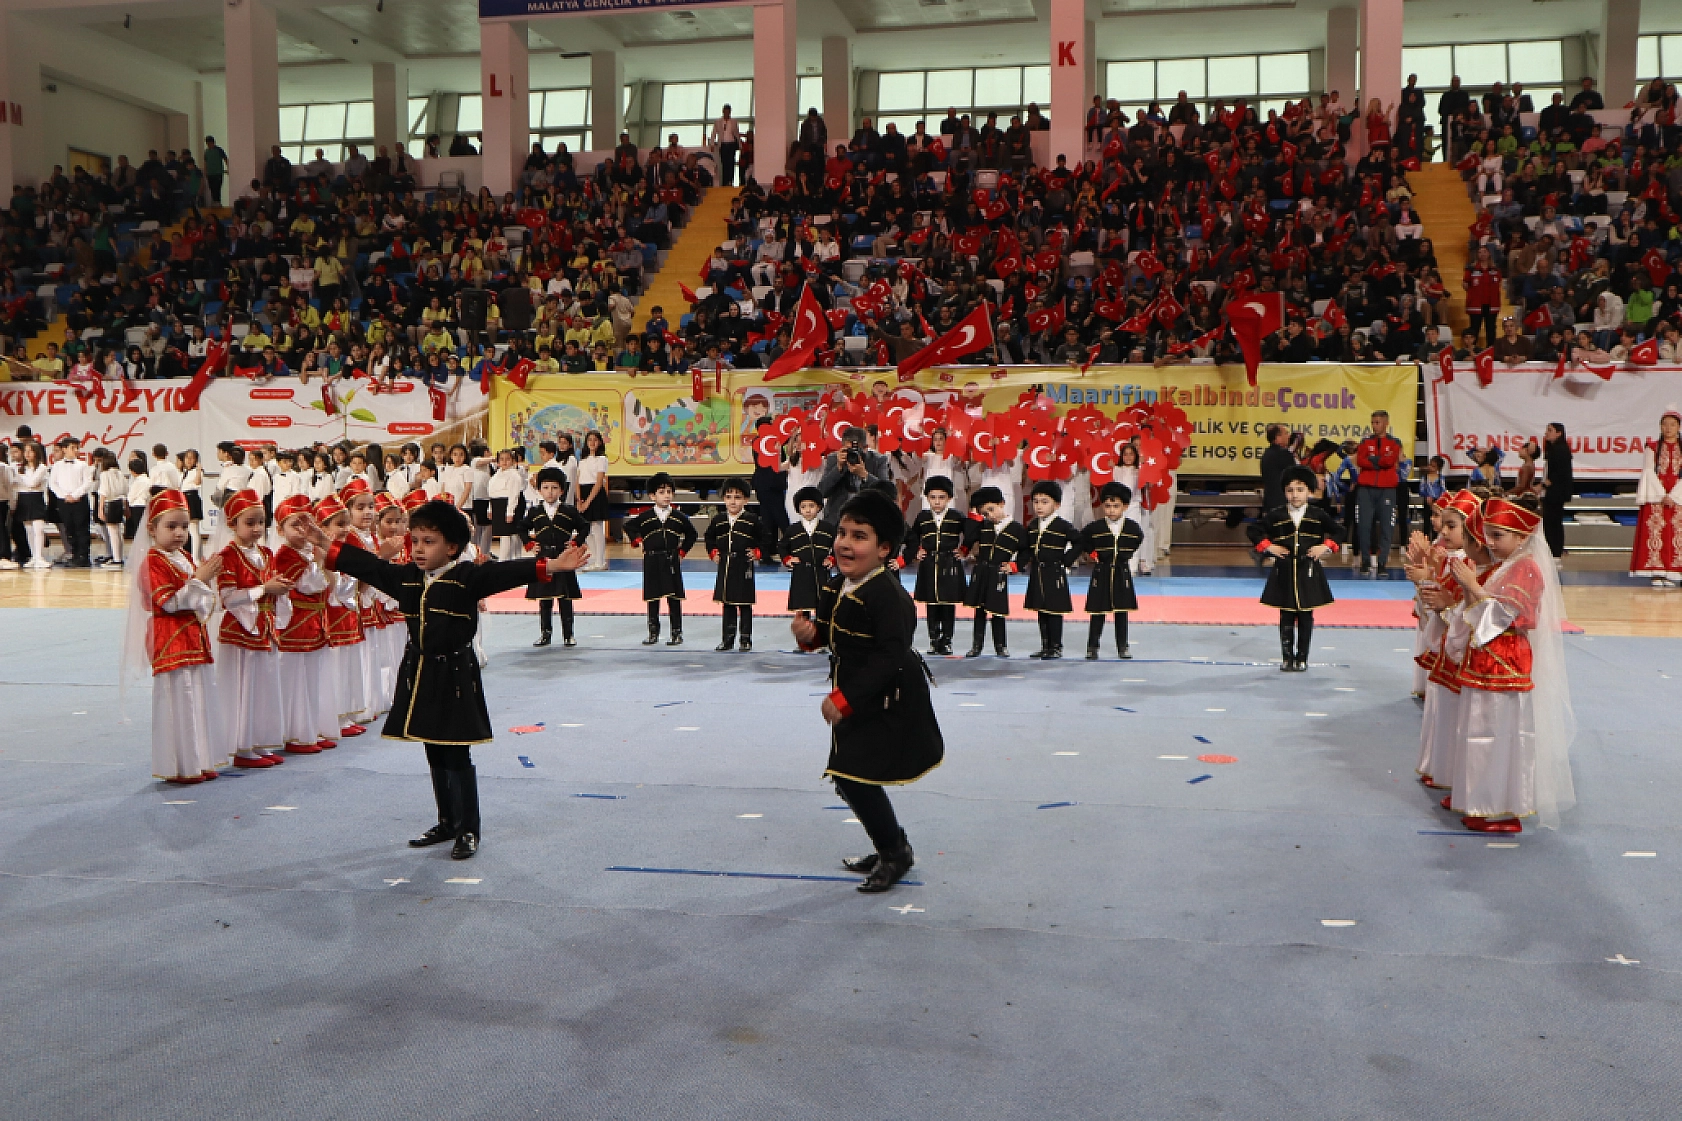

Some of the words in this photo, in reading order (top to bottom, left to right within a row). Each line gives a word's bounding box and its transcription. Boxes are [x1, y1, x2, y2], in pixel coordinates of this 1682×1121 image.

[527, 1, 580, 11] MALATYA
[1058, 41, 1077, 67] K
[490, 73, 502, 97] L
[1228, 421, 1249, 434] VE
[1318, 424, 1394, 437] BAYRAI
[1453, 433, 1478, 450] 23
[1202, 446, 1237, 461] HOŞ
